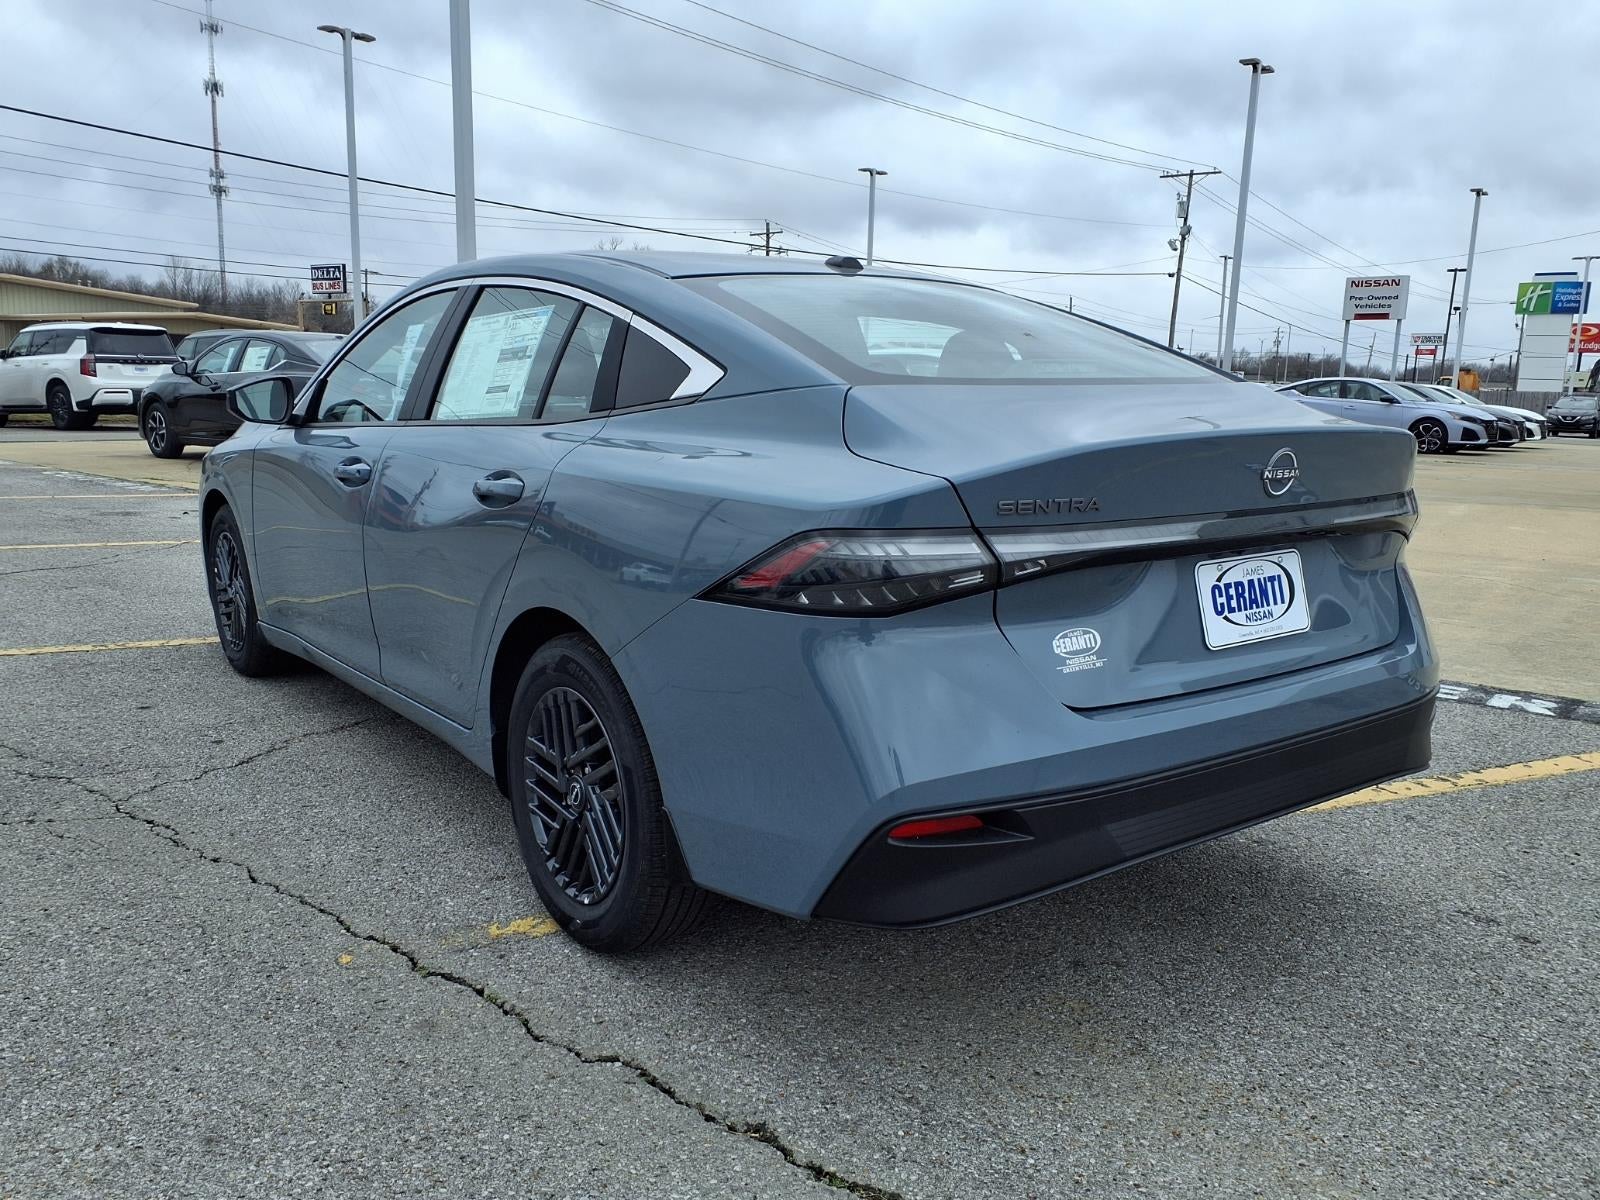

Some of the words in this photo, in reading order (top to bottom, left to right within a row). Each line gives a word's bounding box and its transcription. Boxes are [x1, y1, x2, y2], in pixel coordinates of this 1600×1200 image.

[312, 268, 341, 279] DELTA
[312, 282, 324, 290] BUS
[325, 281, 341, 290] LINES
[1351, 278, 1401, 288] NISSAN
[1554, 293, 1582, 302] Expres
[1263, 467, 1301, 479] NISSAN
[997, 496, 1100, 516] SENTRA
[1242, 565, 1265, 578] JAMES
[1211, 574, 1286, 617] CERANTI
[1245, 609, 1274, 623] NISSAN
[1052, 633, 1096, 654] CERANTI
[1066, 654, 1097, 665] NISSAN
